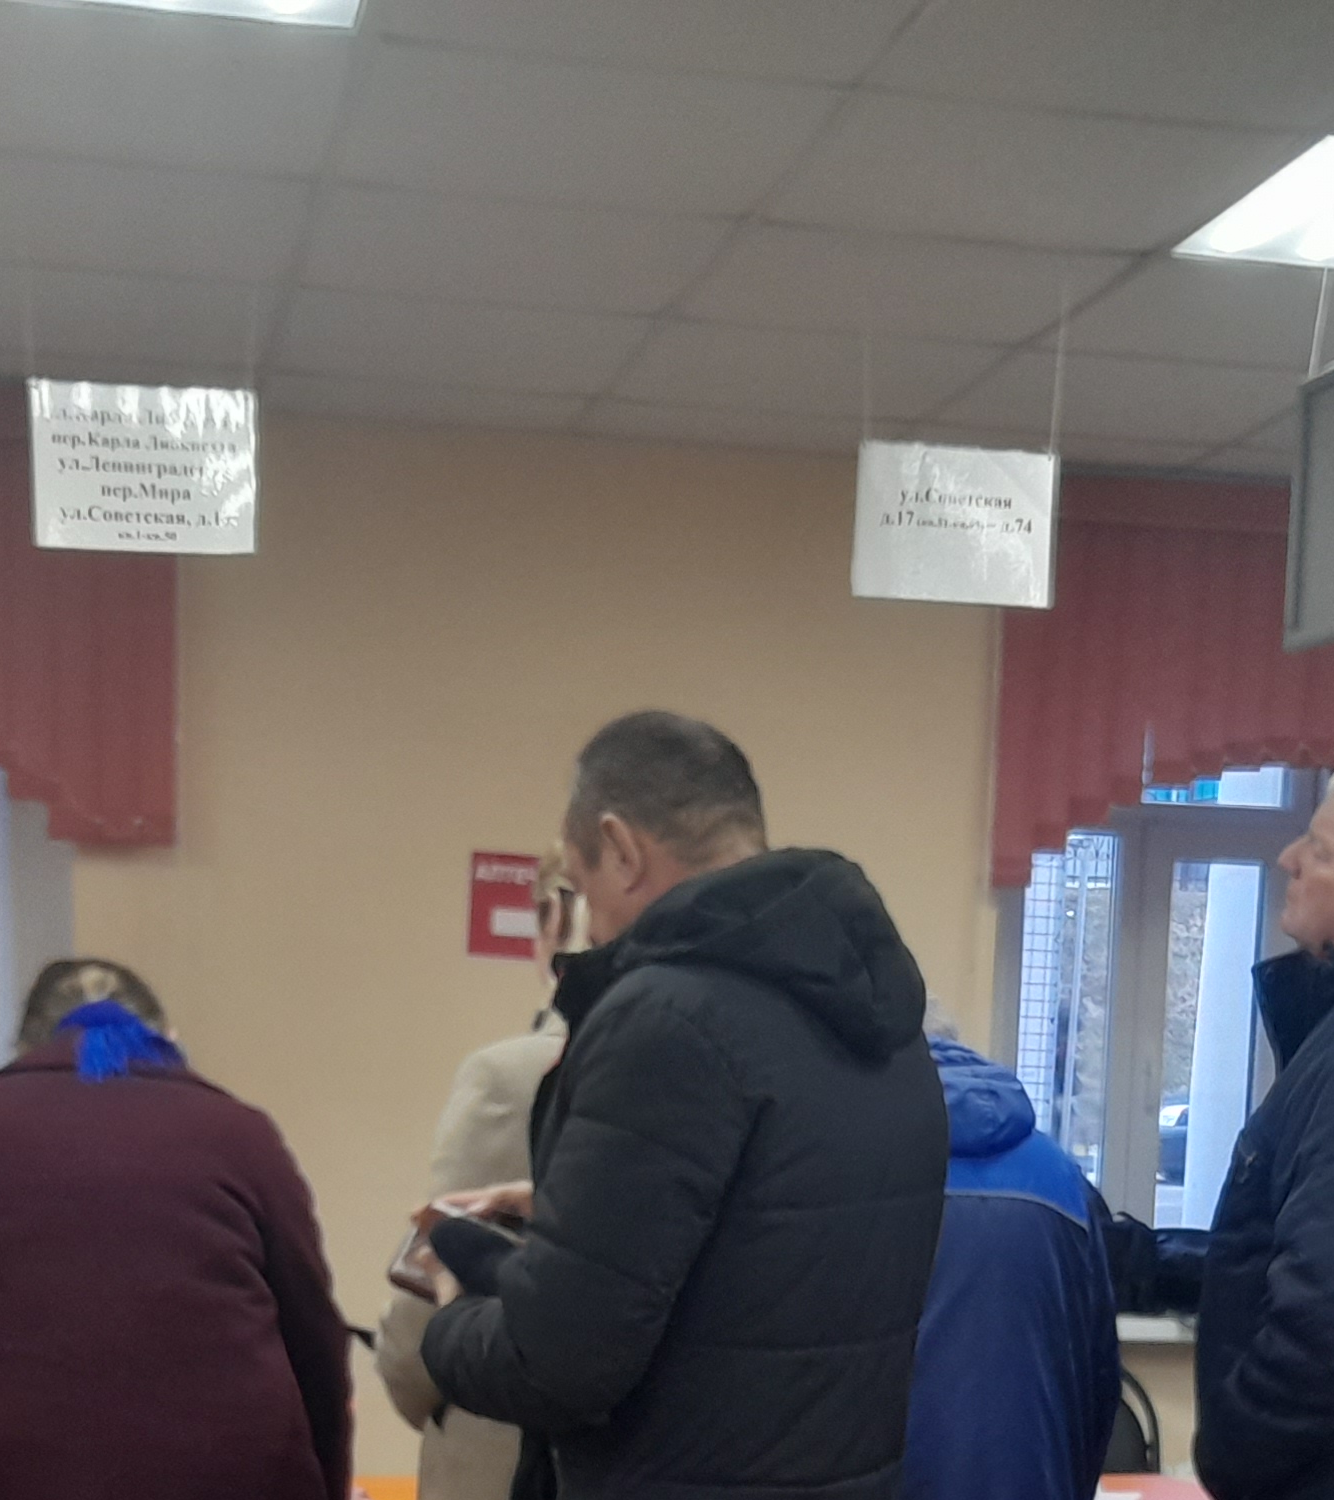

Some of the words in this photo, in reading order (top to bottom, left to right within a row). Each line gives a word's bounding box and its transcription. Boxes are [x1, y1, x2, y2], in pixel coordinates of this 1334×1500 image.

[51, 431, 141, 450] пер.Карла
[100, 482, 192, 506] пер.Мира
[899, 487, 1013, 510] ул.Советская
[58, 504, 193, 530] ул.Советская,
[880, 510, 915, 529] д.17
[999, 517, 1033, 535] д.74
